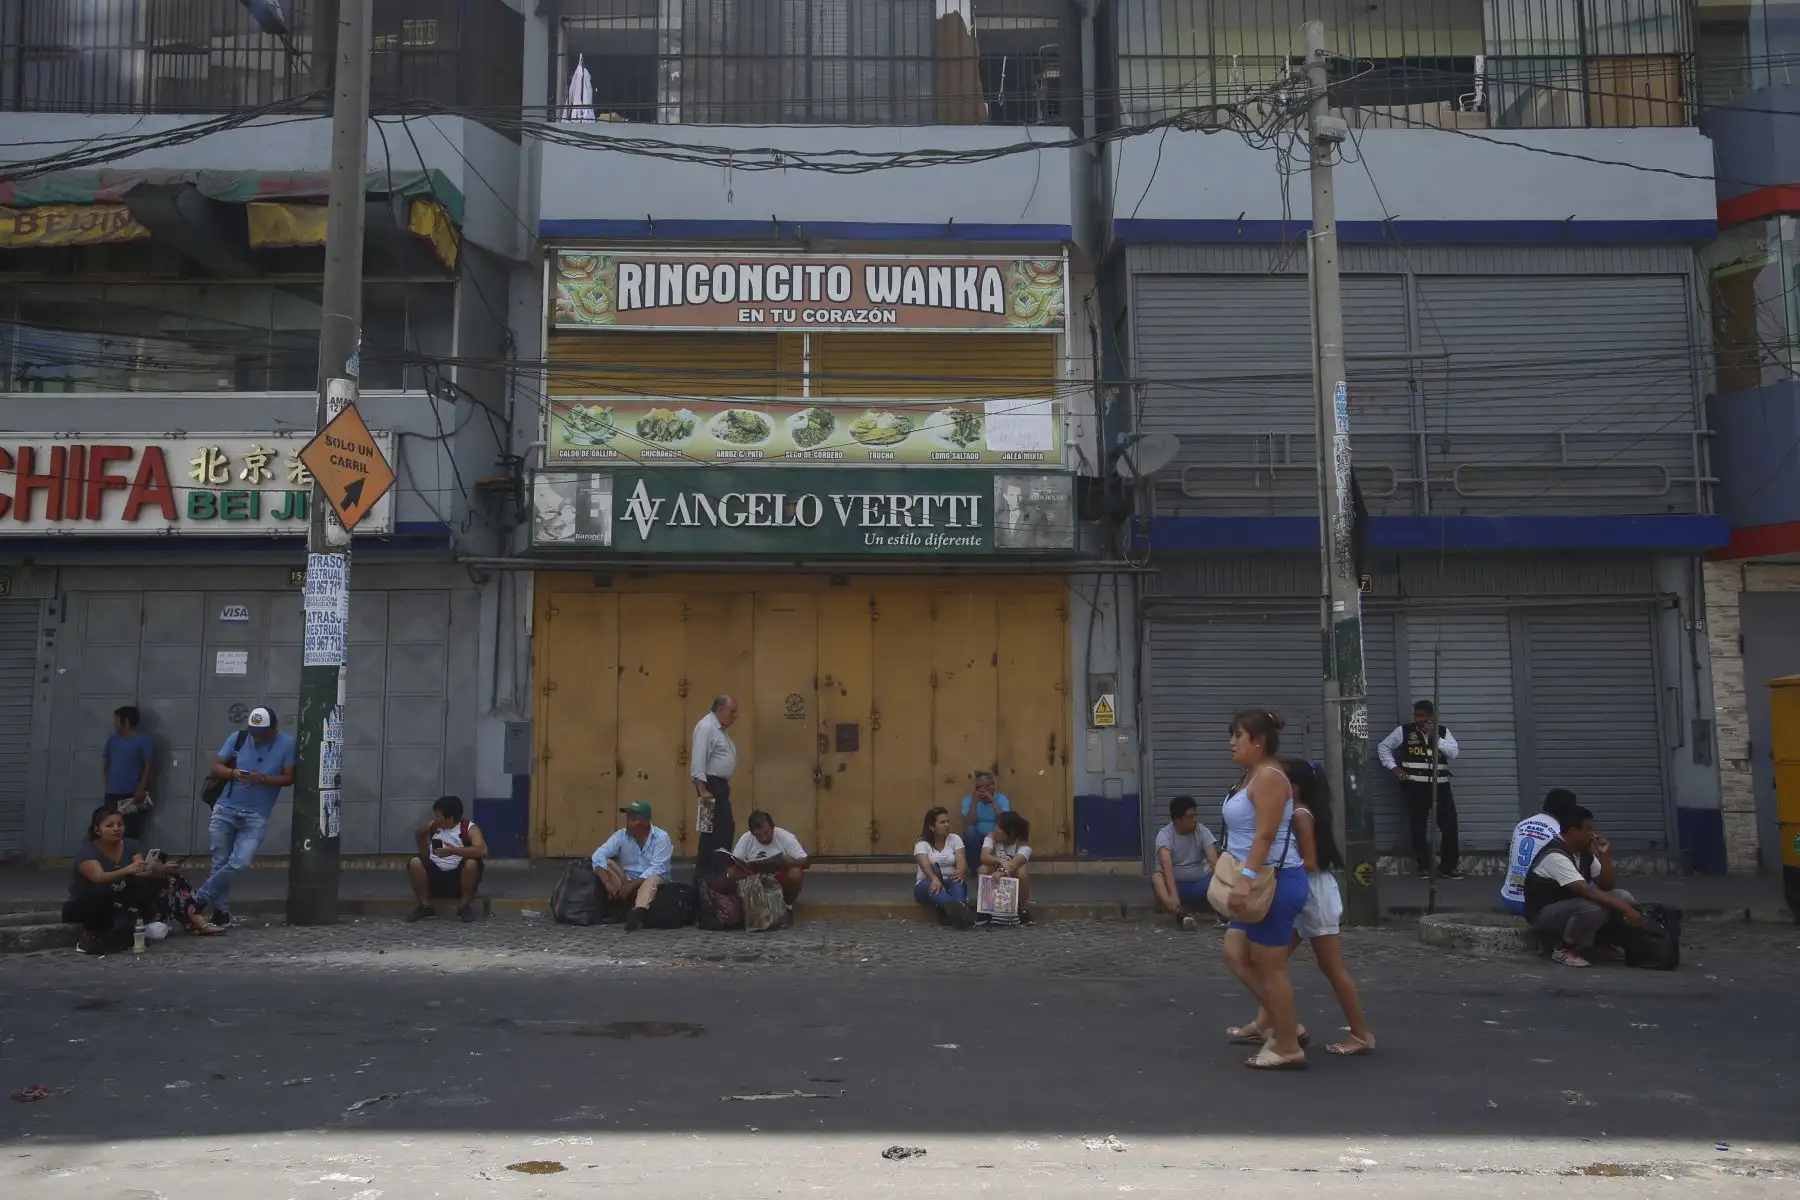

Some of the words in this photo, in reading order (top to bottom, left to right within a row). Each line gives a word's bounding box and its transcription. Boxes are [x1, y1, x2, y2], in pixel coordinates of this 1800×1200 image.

[617, 261, 853, 312] RINCONCITO
[864, 264, 1006, 315] WANKA
[738, 308, 764, 323] EN
[769, 308, 796, 323] TU
[802, 306, 896, 323] CORAZÓN
[325, 435, 355, 452] SOLO
[358, 445, 374, 458] UN
[581, 450, 590, 458] DE
[716, 450, 737, 459] ARROZ
[747, 450, 764, 459] PATO
[329, 454, 369, 474] CARRIL
[803, 451, 813, 459] DE
[813, 451, 844, 460] CORDERO
[868, 451, 895, 460] TRUCHA
[931, 452, 950, 461] LOMO
[951, 452, 980, 461] SALTADO
[1002, 452, 1022, 461] JALEA
[1023, 452, 1044, 461] MIXTA
[187, 490, 261, 521] BEI
[666, 492, 824, 527] ANGELO
[828, 494, 983, 528] VERTTI
[864, 532, 884, 545] Un
[887, 532, 921, 546] estilo
[924, 532, 982, 549] diferente
[222, 608, 248, 617] VISA
[1517, 836, 1536, 867] 9
